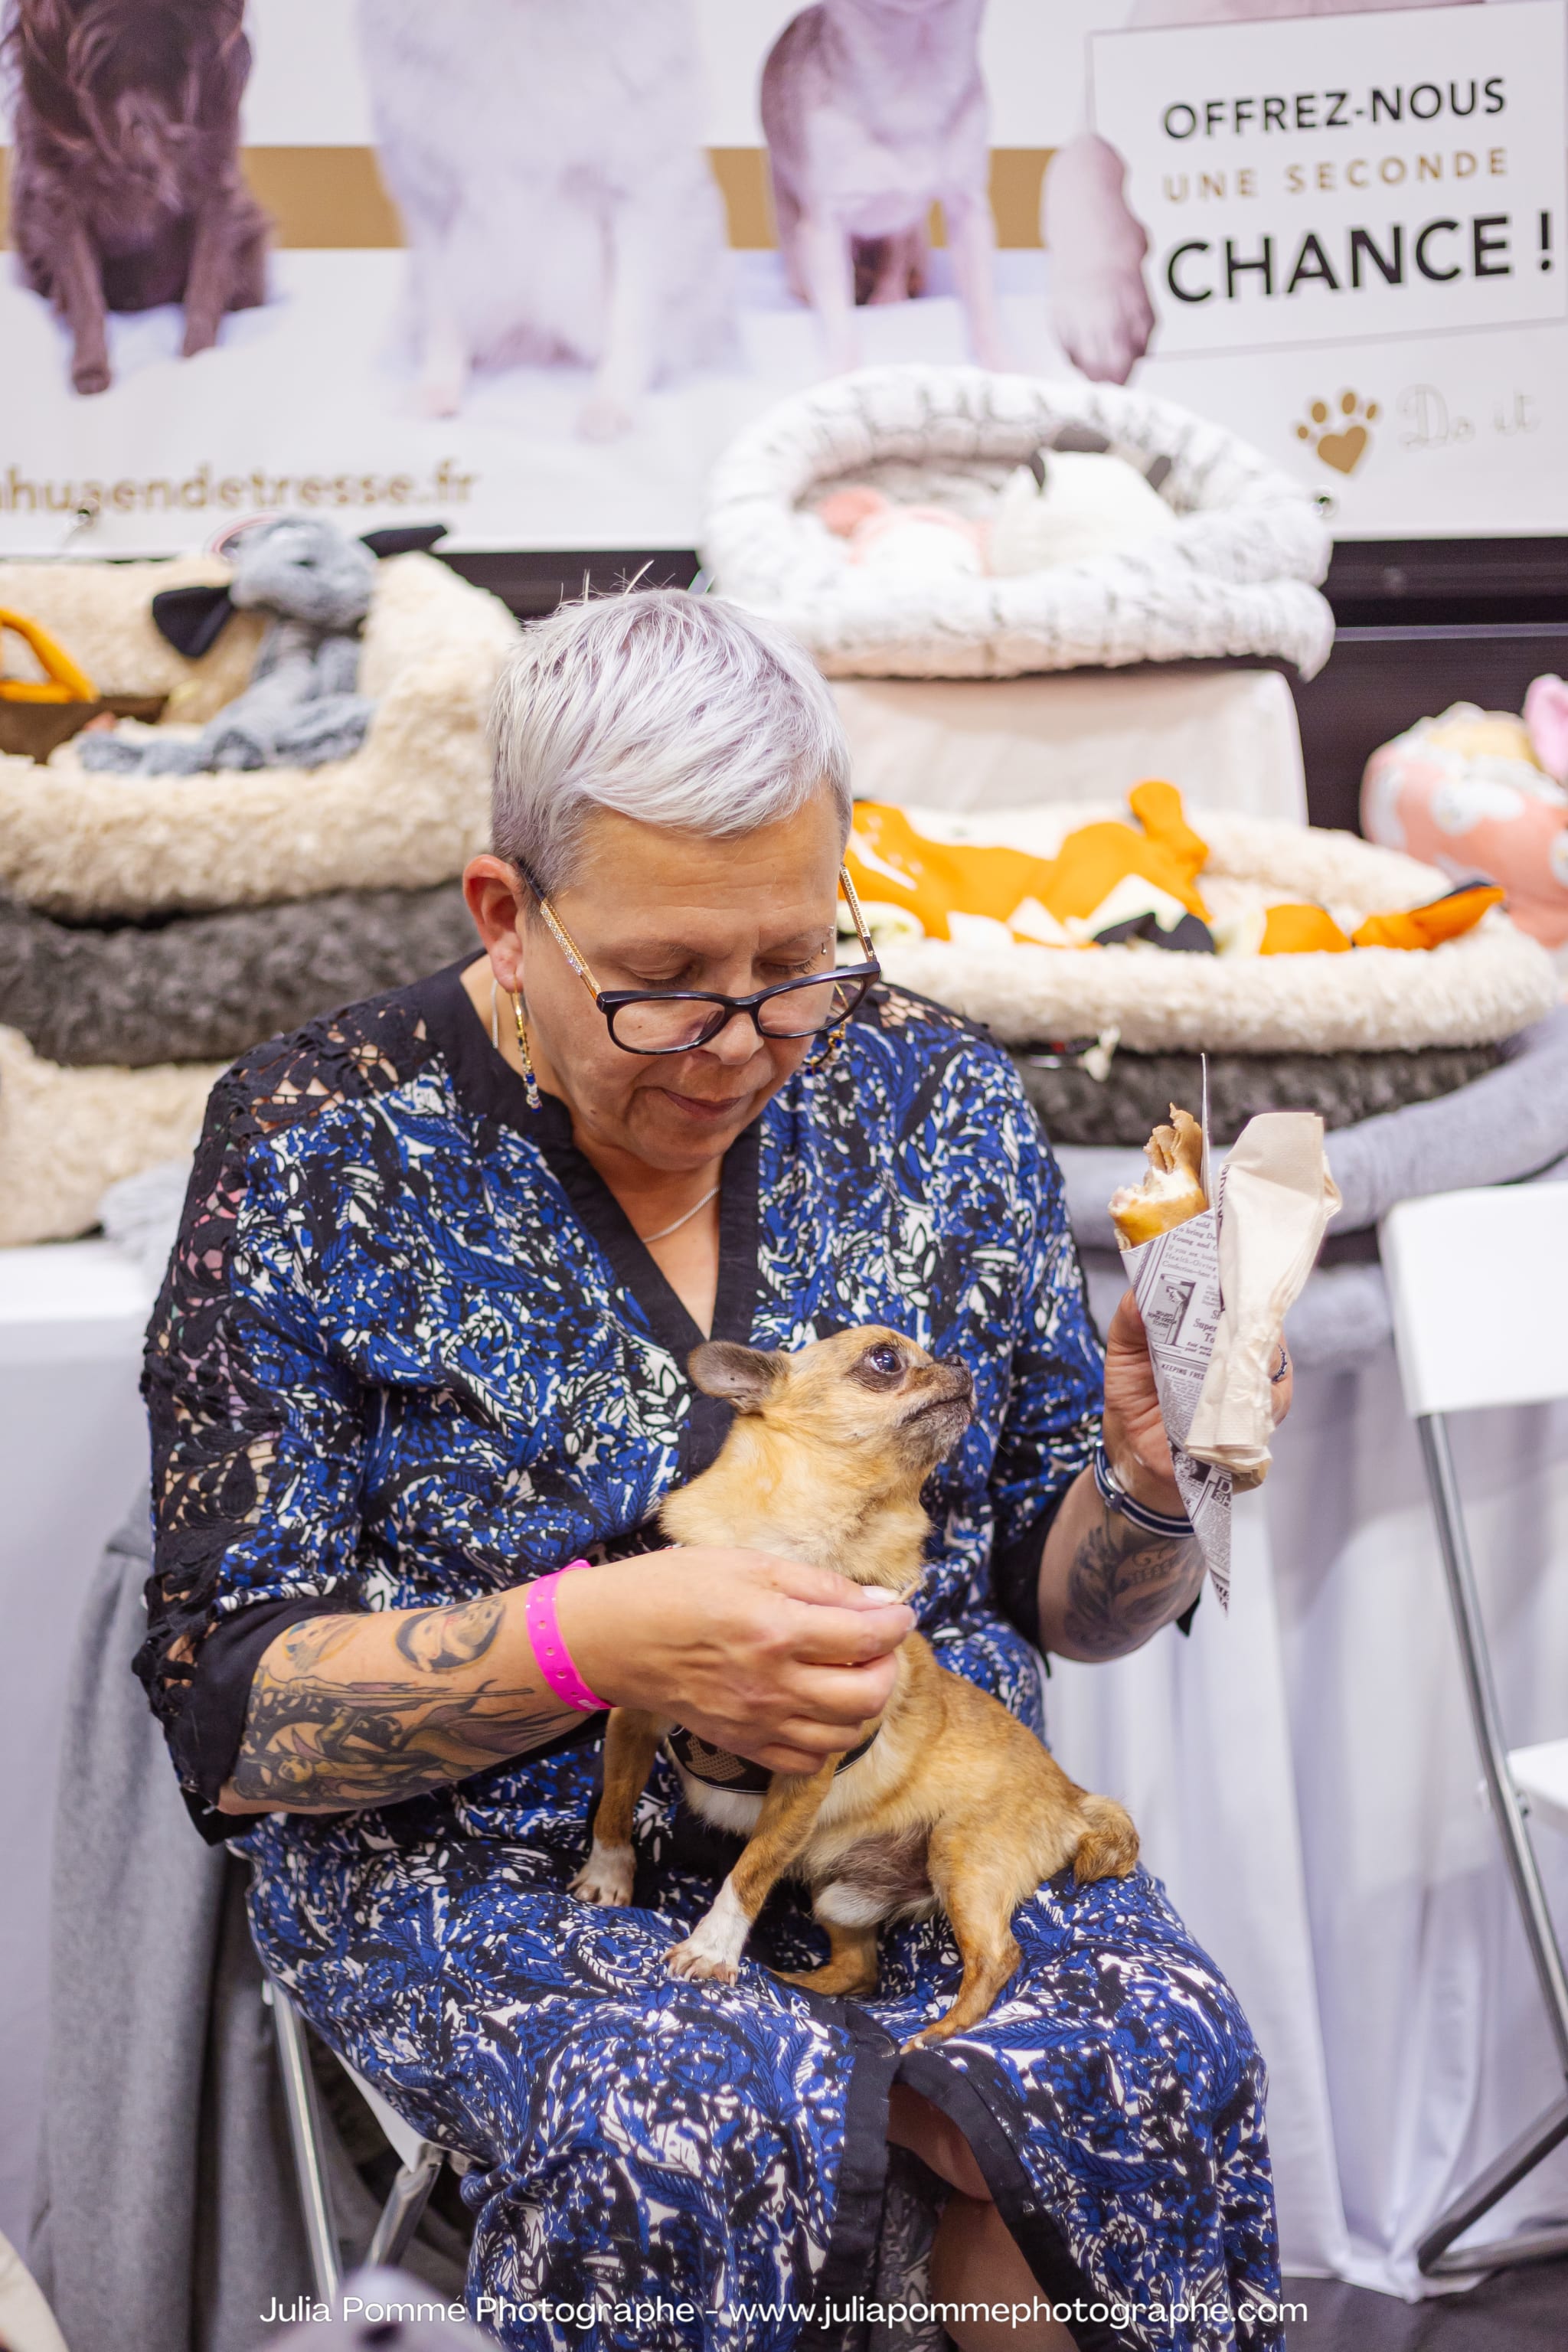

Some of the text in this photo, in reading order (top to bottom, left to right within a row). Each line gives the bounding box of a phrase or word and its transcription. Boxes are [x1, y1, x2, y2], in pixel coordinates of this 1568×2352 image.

[1163, 77, 1505, 139] OFFREZ-NOUS
[1164, 149, 1508, 203] UNE SECONDE
[1168, 215, 1511, 302] CHANCE
